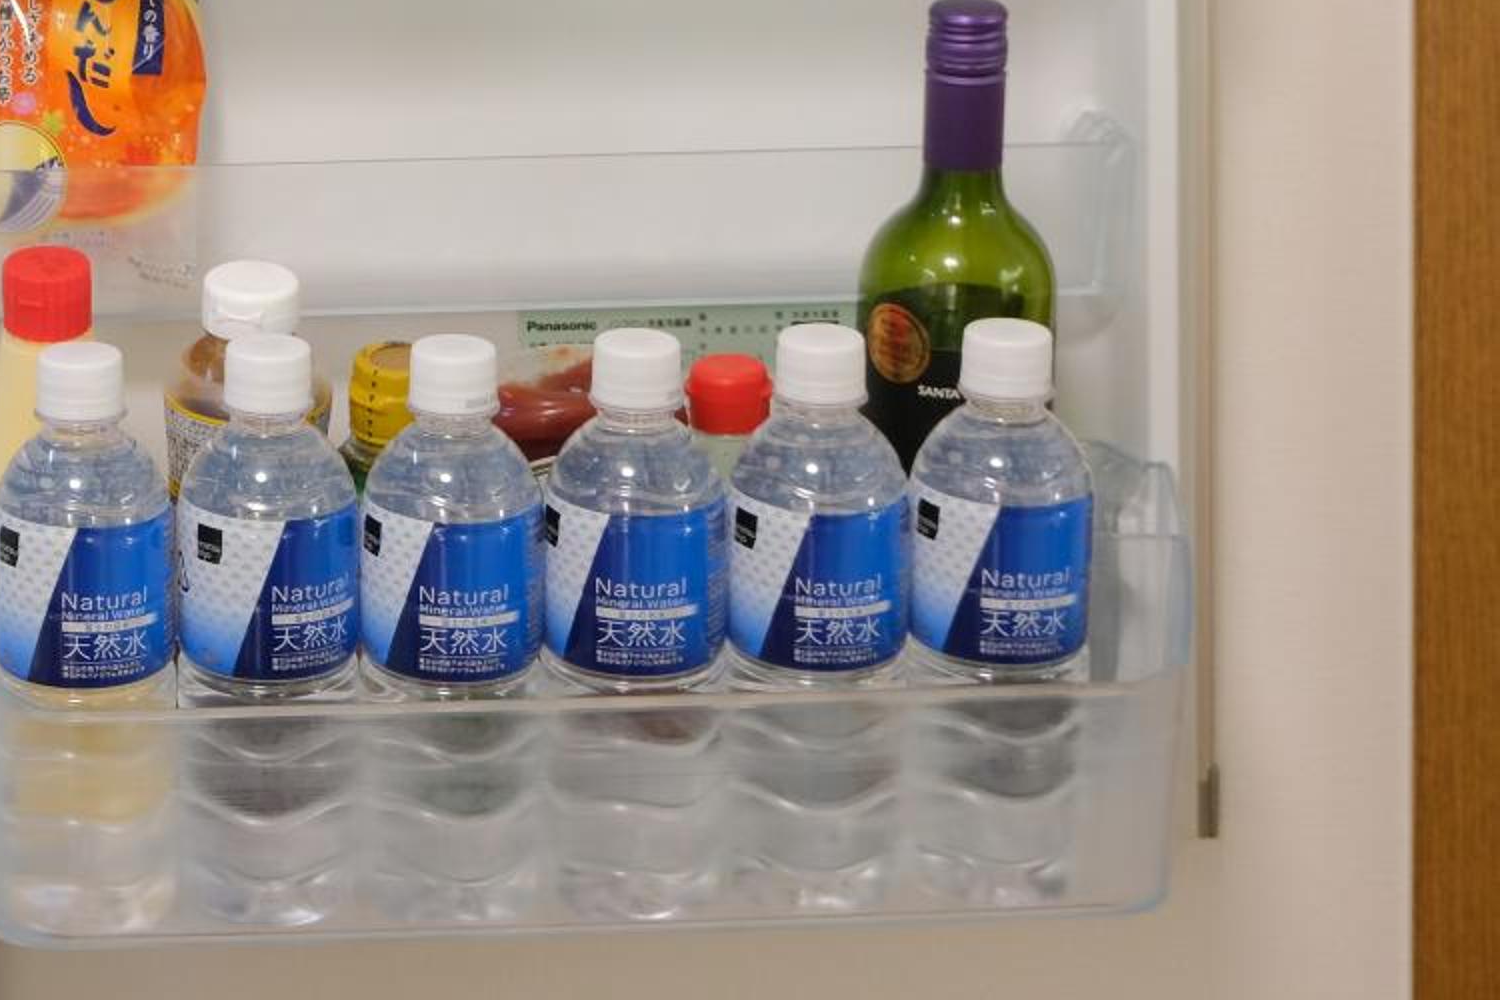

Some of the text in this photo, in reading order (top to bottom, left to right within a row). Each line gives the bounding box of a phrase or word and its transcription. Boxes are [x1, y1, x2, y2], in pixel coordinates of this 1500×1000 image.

[526, 319, 597, 333] Panasonic
[917, 385, 960, 400] SANTA
[271, 573, 349, 603] Natural
[595, 576, 687, 598] Natural
[795, 573, 882, 597] Natural
[981, 567, 1070, 588] Natural
[61, 585, 148, 612] Natural
[419, 583, 509, 606] Natural
[595, 597, 644, 609] Mineral
[61, 610, 110, 621] Mineral
[271, 602, 318, 613] Mineral
[419, 604, 467, 616] Mineral
[273, 615, 348, 652] 天然水
[597, 620, 686, 647] 天然水
[796, 618, 881, 645] 天然水
[981, 609, 1066, 637] 天然水
[63, 631, 148, 661] 天然水
[420, 627, 508, 655] 天然水
